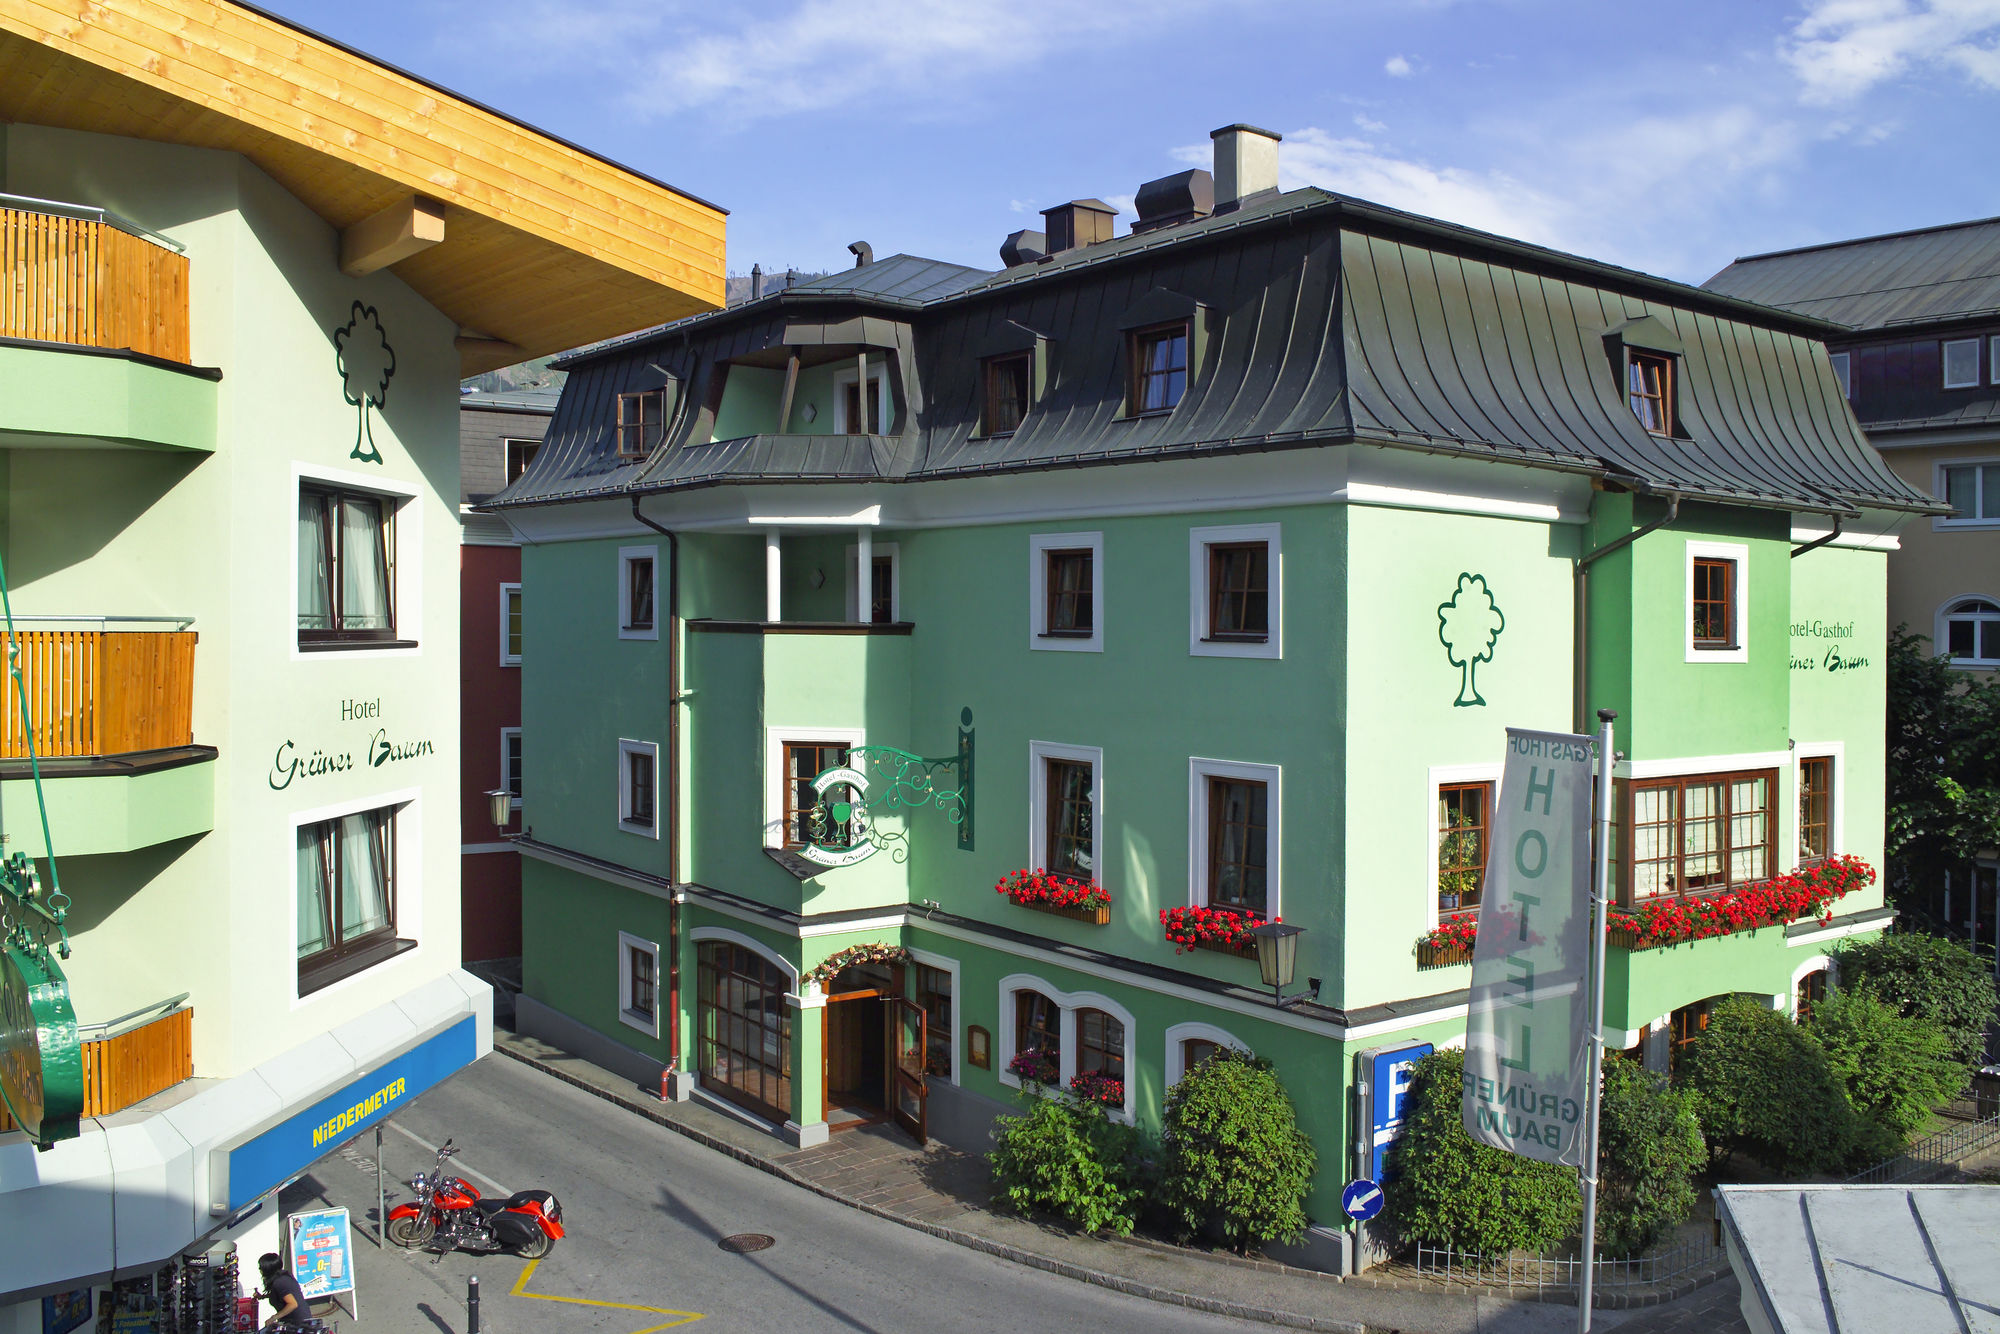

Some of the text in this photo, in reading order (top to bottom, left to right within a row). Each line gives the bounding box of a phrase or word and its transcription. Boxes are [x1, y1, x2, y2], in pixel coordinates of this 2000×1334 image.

[1789, 620, 1854, 639] otel-Gasthof
[1823, 644, 1869, 673] Baum
[341, 698, 381, 721] Hotel
[268, 727, 435, 791] Grüner Baum
